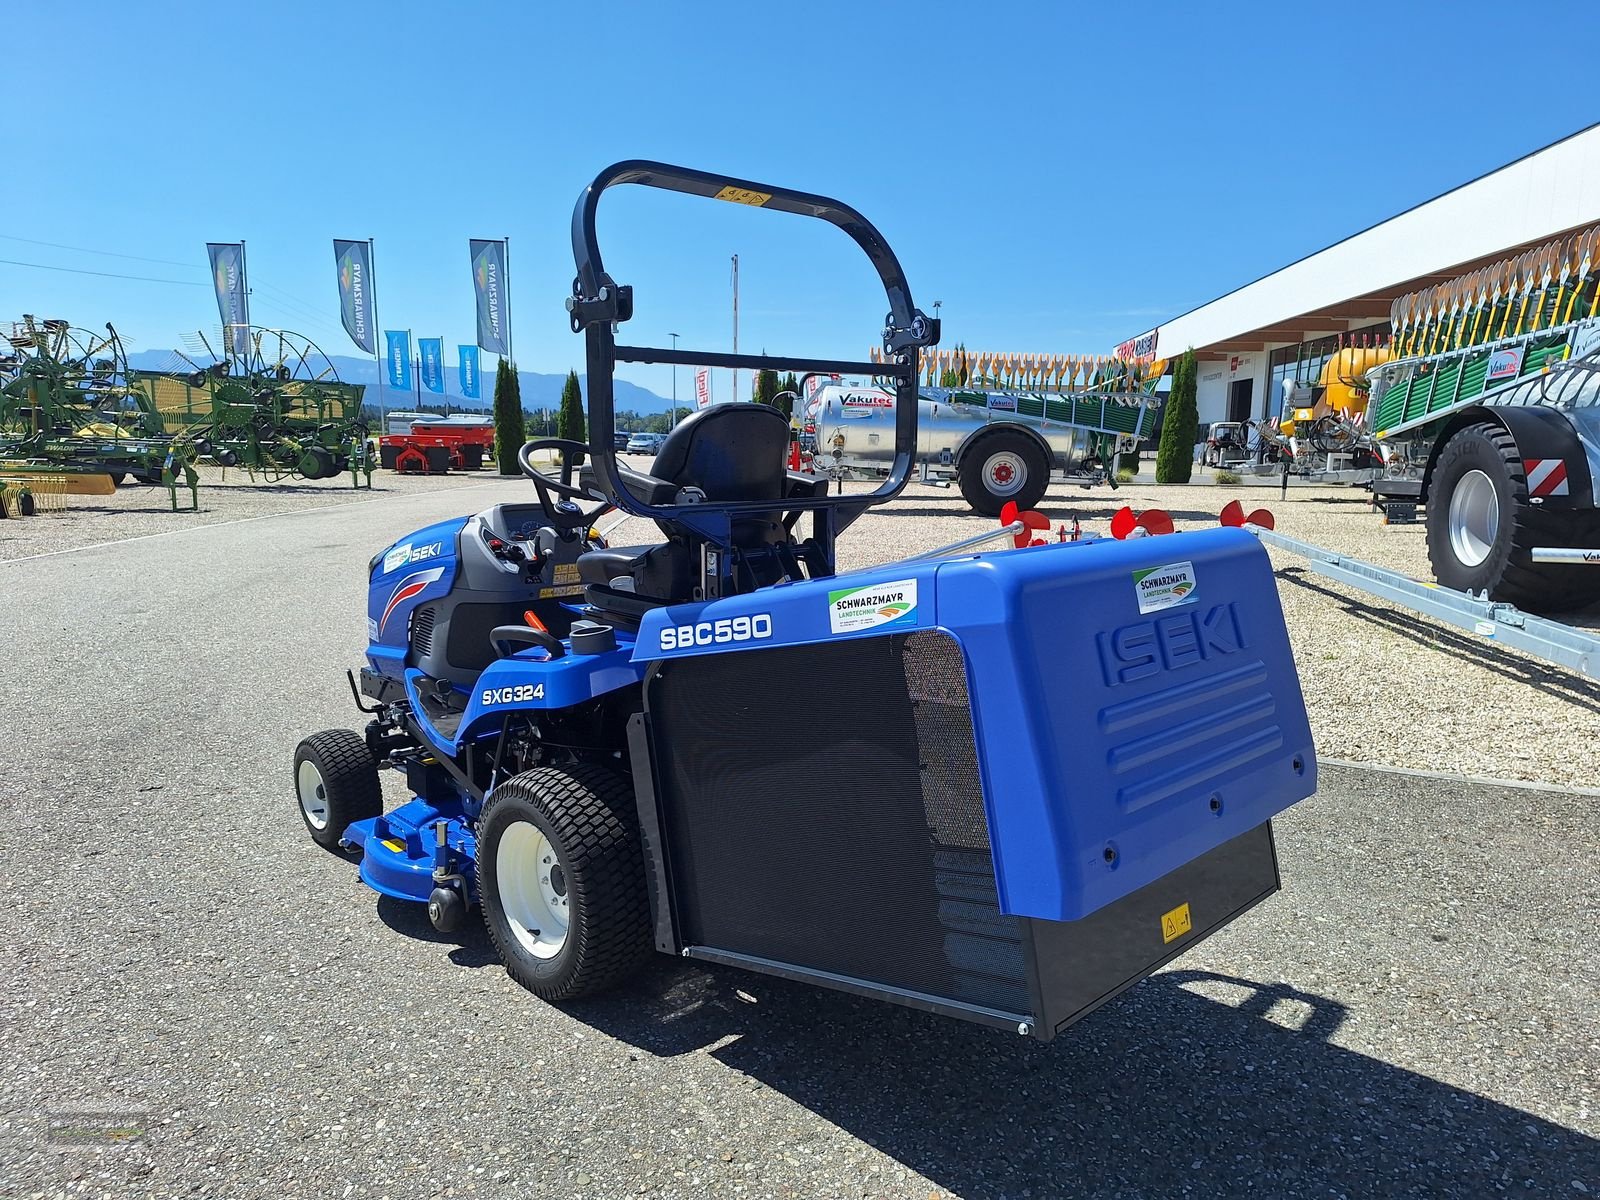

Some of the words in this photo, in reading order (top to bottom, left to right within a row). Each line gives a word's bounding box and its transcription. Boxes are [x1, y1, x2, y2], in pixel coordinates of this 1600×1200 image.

[839, 393, 893, 406] Vakutec
[408, 542, 442, 563] ISEKI
[1141, 573, 1187, 590] SCHWARZMAYR
[836, 592, 904, 611] SCHWARZMAYR
[838, 608, 876, 619] LANDTECHNIK
[660, 614, 773, 650] SBC590
[1095, 602, 1249, 687] ISEKI
[482, 683, 545, 706] SXG324
